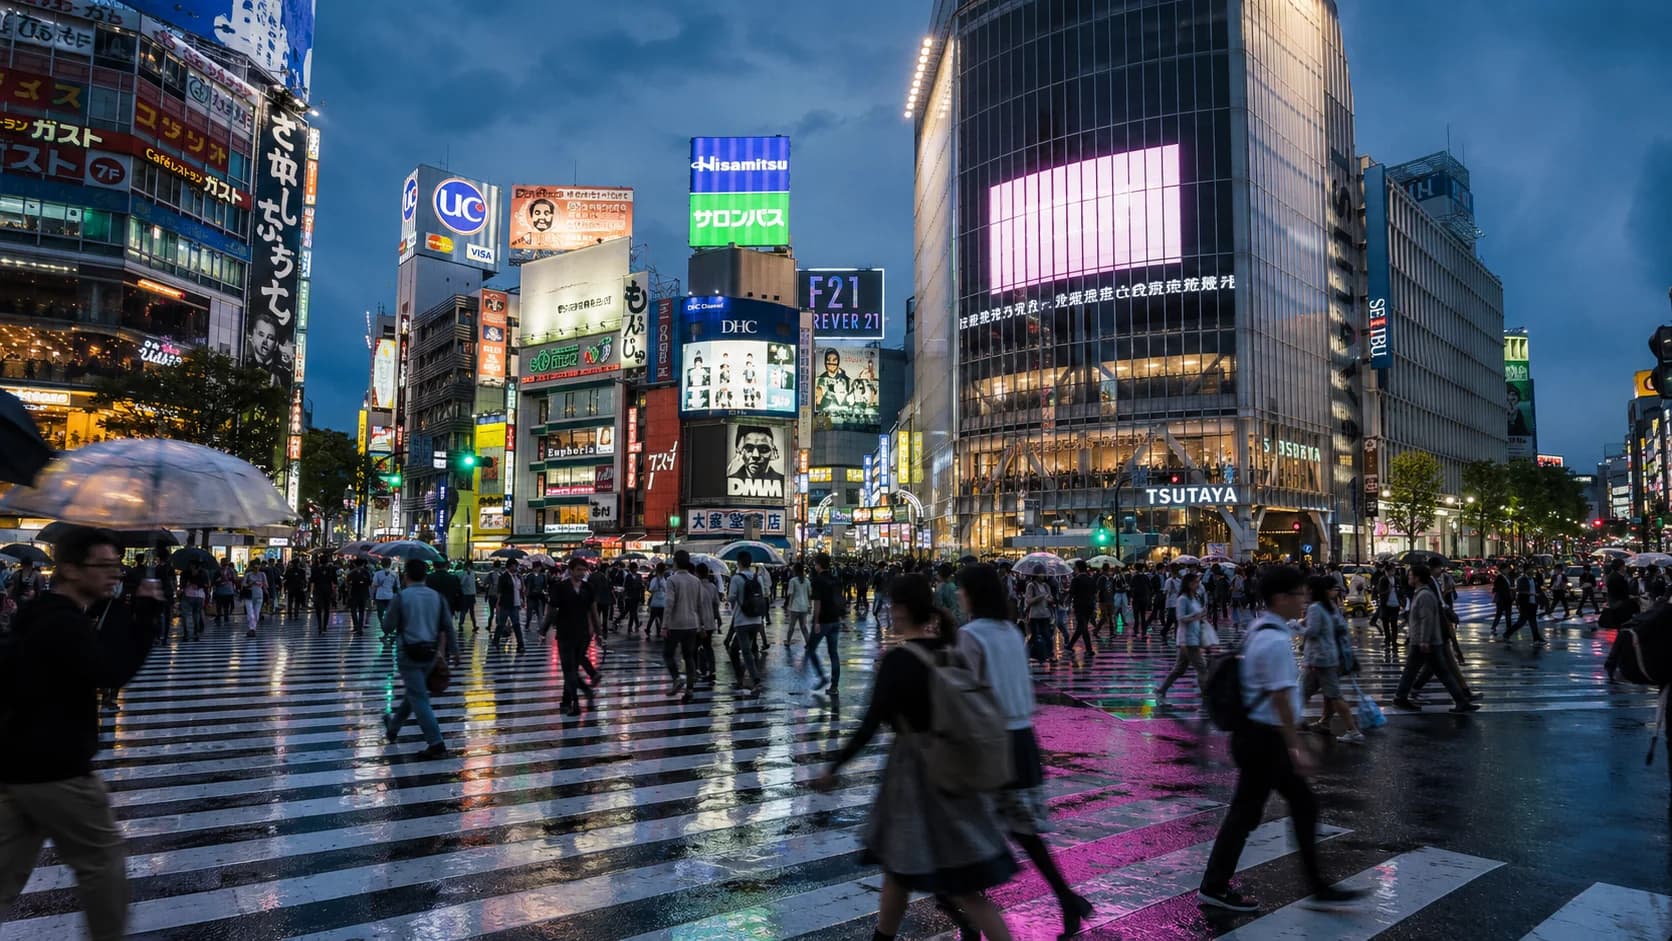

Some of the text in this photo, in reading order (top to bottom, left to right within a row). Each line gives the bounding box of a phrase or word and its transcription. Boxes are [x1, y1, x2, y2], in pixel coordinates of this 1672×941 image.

[0, 118, 103, 148] ラン ガスト
[95, 164, 120, 180] 7F
[691, 156, 788, 172] Hisamitsu
[204, 176, 242, 204] ガスト
[440, 189, 483, 223] UC
[693, 208, 785, 228] サロンパス
[471, 247, 493, 260] VISA
[809, 276, 859, 309] F21
[721, 320, 758, 334] DHC
[814, 313, 879, 329] REVER 21
[547, 445, 594, 457] Euphoria
[727, 478, 782, 497] DMM
[1146, 487, 1238, 504] TSUTAYA
